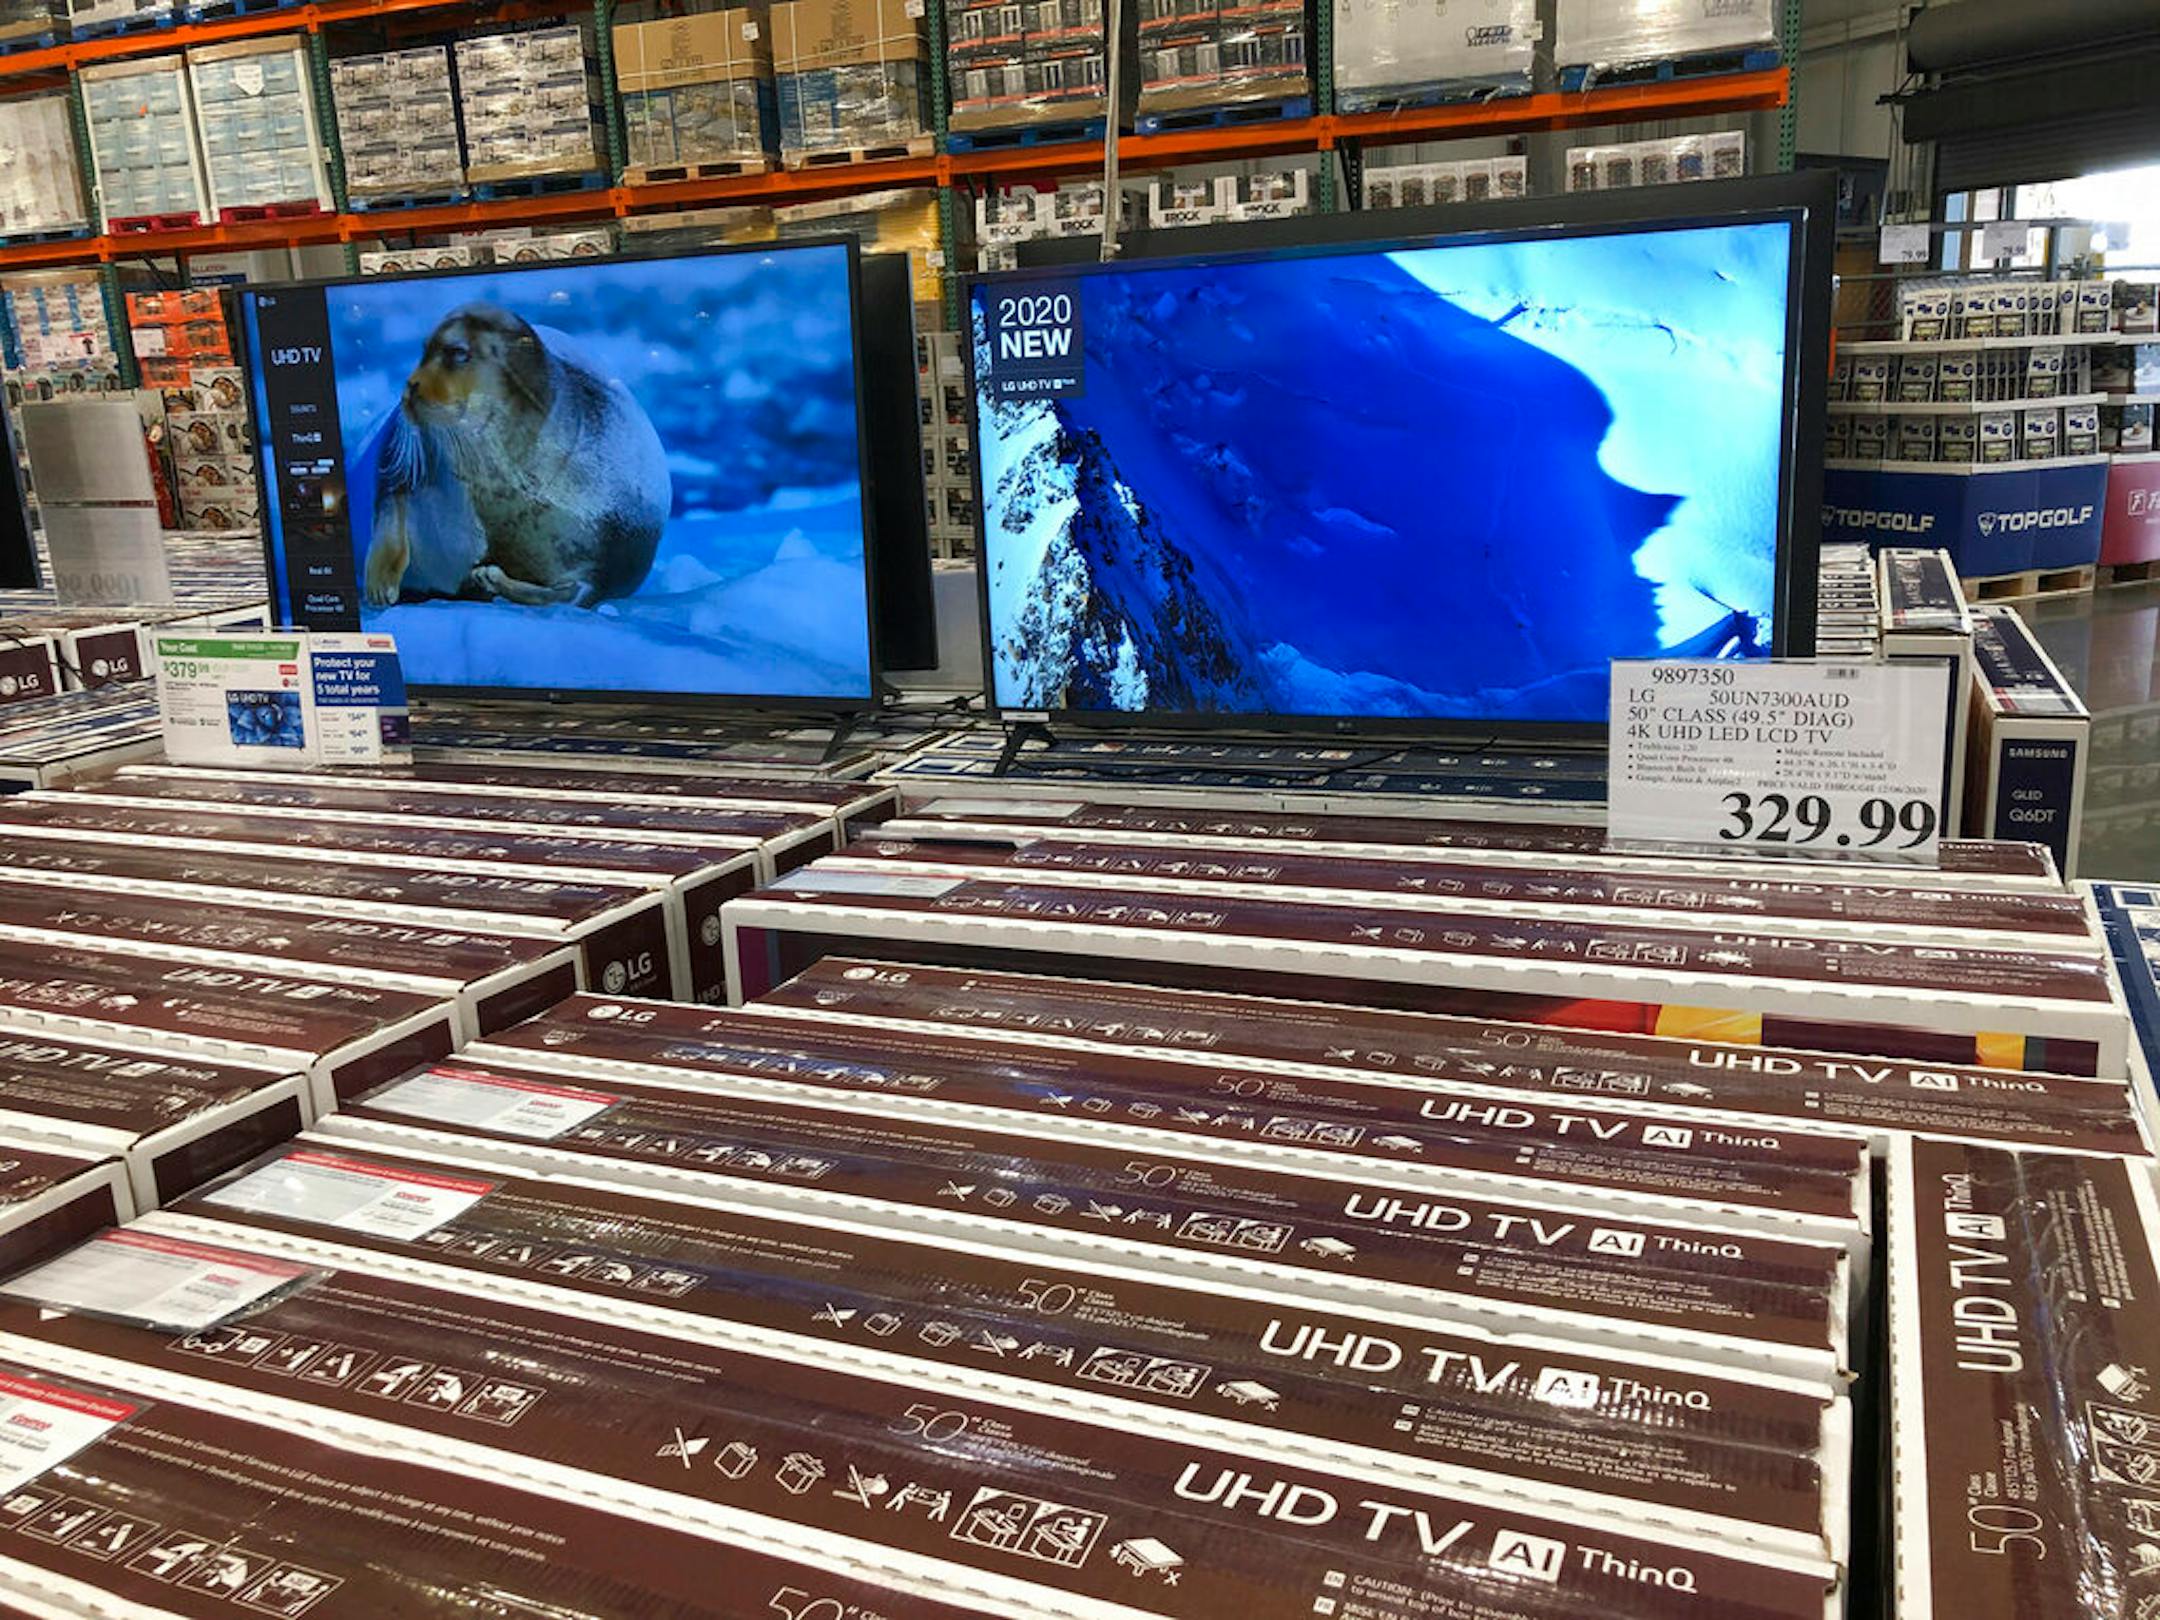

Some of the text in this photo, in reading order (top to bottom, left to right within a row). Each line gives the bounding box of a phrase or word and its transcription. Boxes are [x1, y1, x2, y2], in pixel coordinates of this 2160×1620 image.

[1901, 250, 1928, 260] 79.99
[999, 295, 1072, 327] 2020
[1001, 328, 1073, 360] NEW
[271, 347, 321, 365] UHD TV
[1001, 378, 1052, 392] LG UHD TV
[1836, 509, 1935, 533] TOPGOLF
[1998, 506, 2093, 533] TOPGOLF
[159, 641, 198, 654] Your Cost
[109, 657, 129, 673] LG
[314, 657, 377, 671] Protect your
[18, 674, 39, 690] LG
[316, 669, 371, 682] new TV for
[1652, 668, 1735, 686] 9897350
[317, 684, 323, 695] 5
[324, 683, 350, 695] total
[1629, 688, 1849, 709] LG 50UN7300AUD
[1627, 706, 1855, 729] 50" CLASS (49.5" DIAG)
[1627, 724, 1833, 745] 4K UHD LED LCD TV
[1847, 750, 1885, 759] Included
[2008, 747, 2068, 760] SAMSUNG
[1671, 775, 1693, 784] Alexa
[1757, 780, 1786, 789] PRICE
[1789, 781, 1822, 791] VALID
[1824, 782, 1874, 793] THROUGH
[2011, 788, 2044, 801] QLED
[1718, 791, 1937, 849] 329.99
[2008, 808, 2057, 824] Q6DT
[408, 873, 479, 887] UHD
[306, 919, 381, 938] UHD
[378, 923, 428, 941] TV
[628, 953, 652, 981] LG
[874, 970, 912, 984] LG
[161, 966, 244, 988] UHD
[238, 976, 296, 998] TV
[619, 1008, 657, 1023] LG
[60, 1052, 122, 1072] TV
[1689, 1049, 2049, 1095] UHD TV AI ThinQ
[1419, 1098, 1782, 1151] UHD TV AI ThinQ
[1941, 1172, 1974, 1210] ThinQ
[1344, 1193, 1745, 1261] UHD TV AI ThinQ
[1951, 1215, 2000, 1239] AI
[1948, 1243, 2013, 1290] TV
[1952, 1295, 2024, 1373] UHD
[1259, 1319, 1712, 1412] UHD TV AI ThinQ
[977, 1426, 1014, 1439] Classe
[982, 1418, 1013, 1432] Class
[475, 1514, 513, 1531] without
[1173, 1461, 1699, 1595] UHD TV AI ThinQ
[1351, 1586, 1365, 1596] to
[1408, 1598, 1430, 1613] top
[1431, 1603, 1446, 1615] of
[1353, 1574, 1414, 1596] CAUTION:
[1459, 1600, 1473, 1612] to
